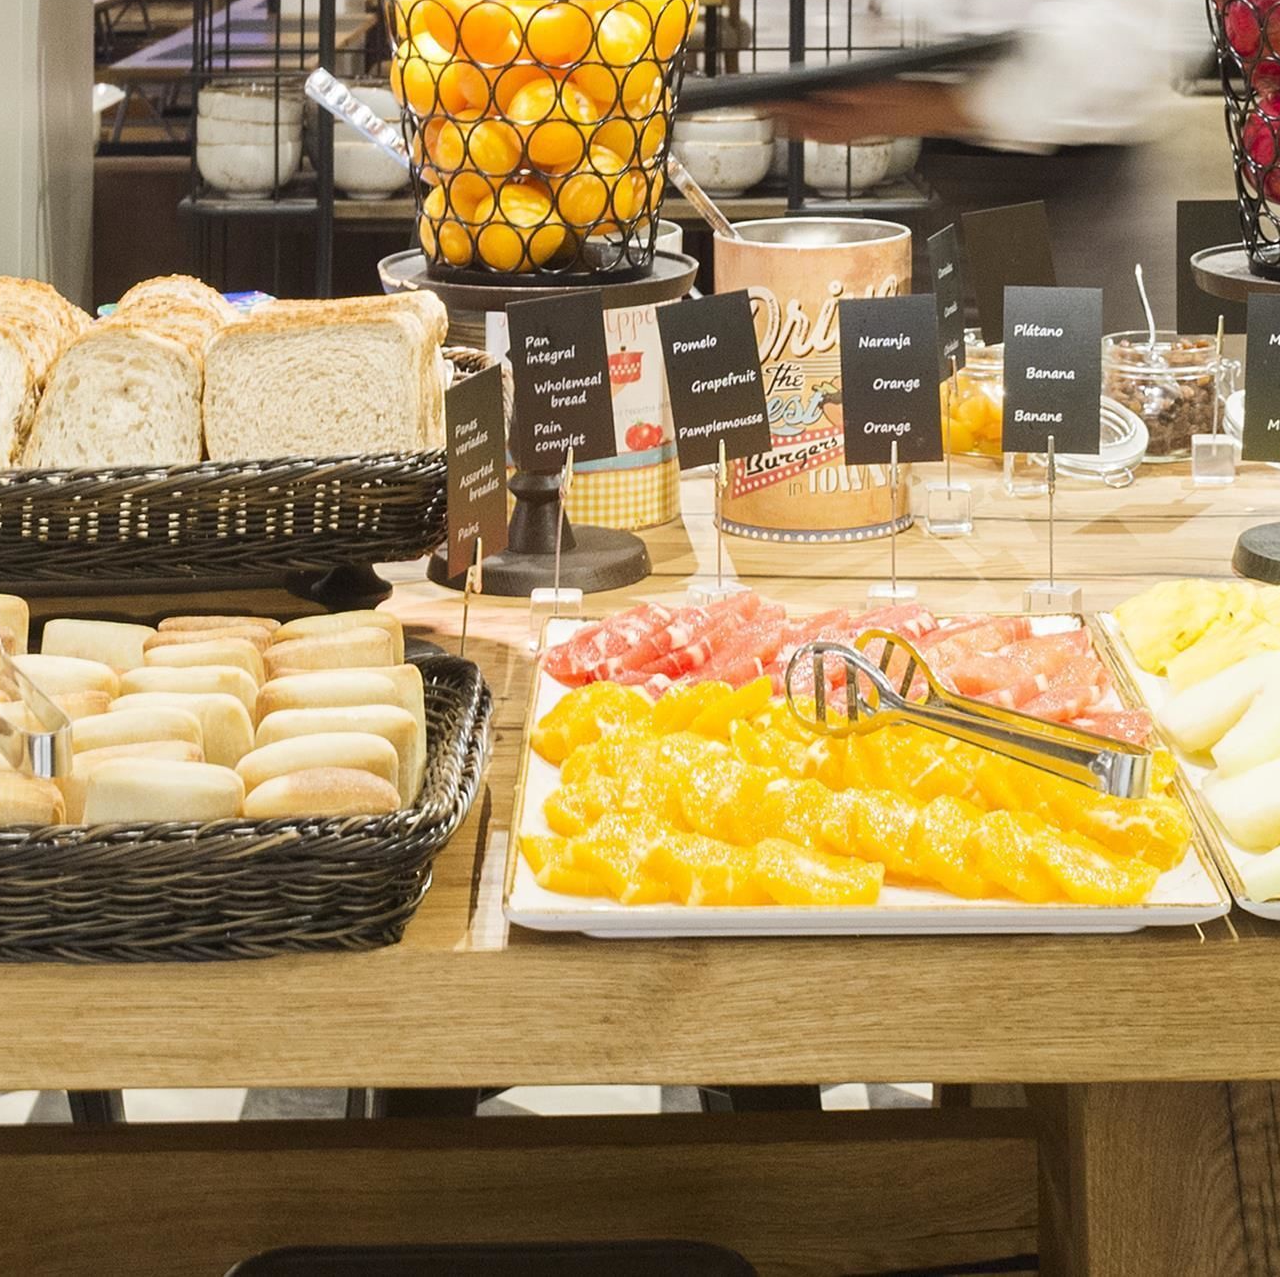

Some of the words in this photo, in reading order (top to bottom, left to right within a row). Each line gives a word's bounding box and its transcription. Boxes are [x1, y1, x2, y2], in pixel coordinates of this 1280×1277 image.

[1014, 323, 1063, 337] Plátano
[525, 335, 550, 349] Pan
[673, 334, 718, 355] Pomelo
[858, 333, 911, 350] Naranja
[526, 345, 576, 366] integral
[534, 372, 602, 395] Wholemeal
[691, 370, 757, 394] Grapefruit
[1026, 367, 1075, 380] Banana
[872, 378, 920, 393] Orange
[551, 391, 587, 408] bread
[766, 390, 824, 426] est
[1014, 409, 1063, 422] Banane
[454, 418, 478, 439] Panes
[534, 420, 562, 437] Pain
[679, 413, 764, 440] Pamplemousse
[864, 421, 911, 436] Orange
[455, 430, 489, 457] variados
[535, 433, 586, 453] complet
[746, 437, 838, 476] Burgers
[459, 458, 495, 490] Assorted
[457, 522, 480, 543] Pains
